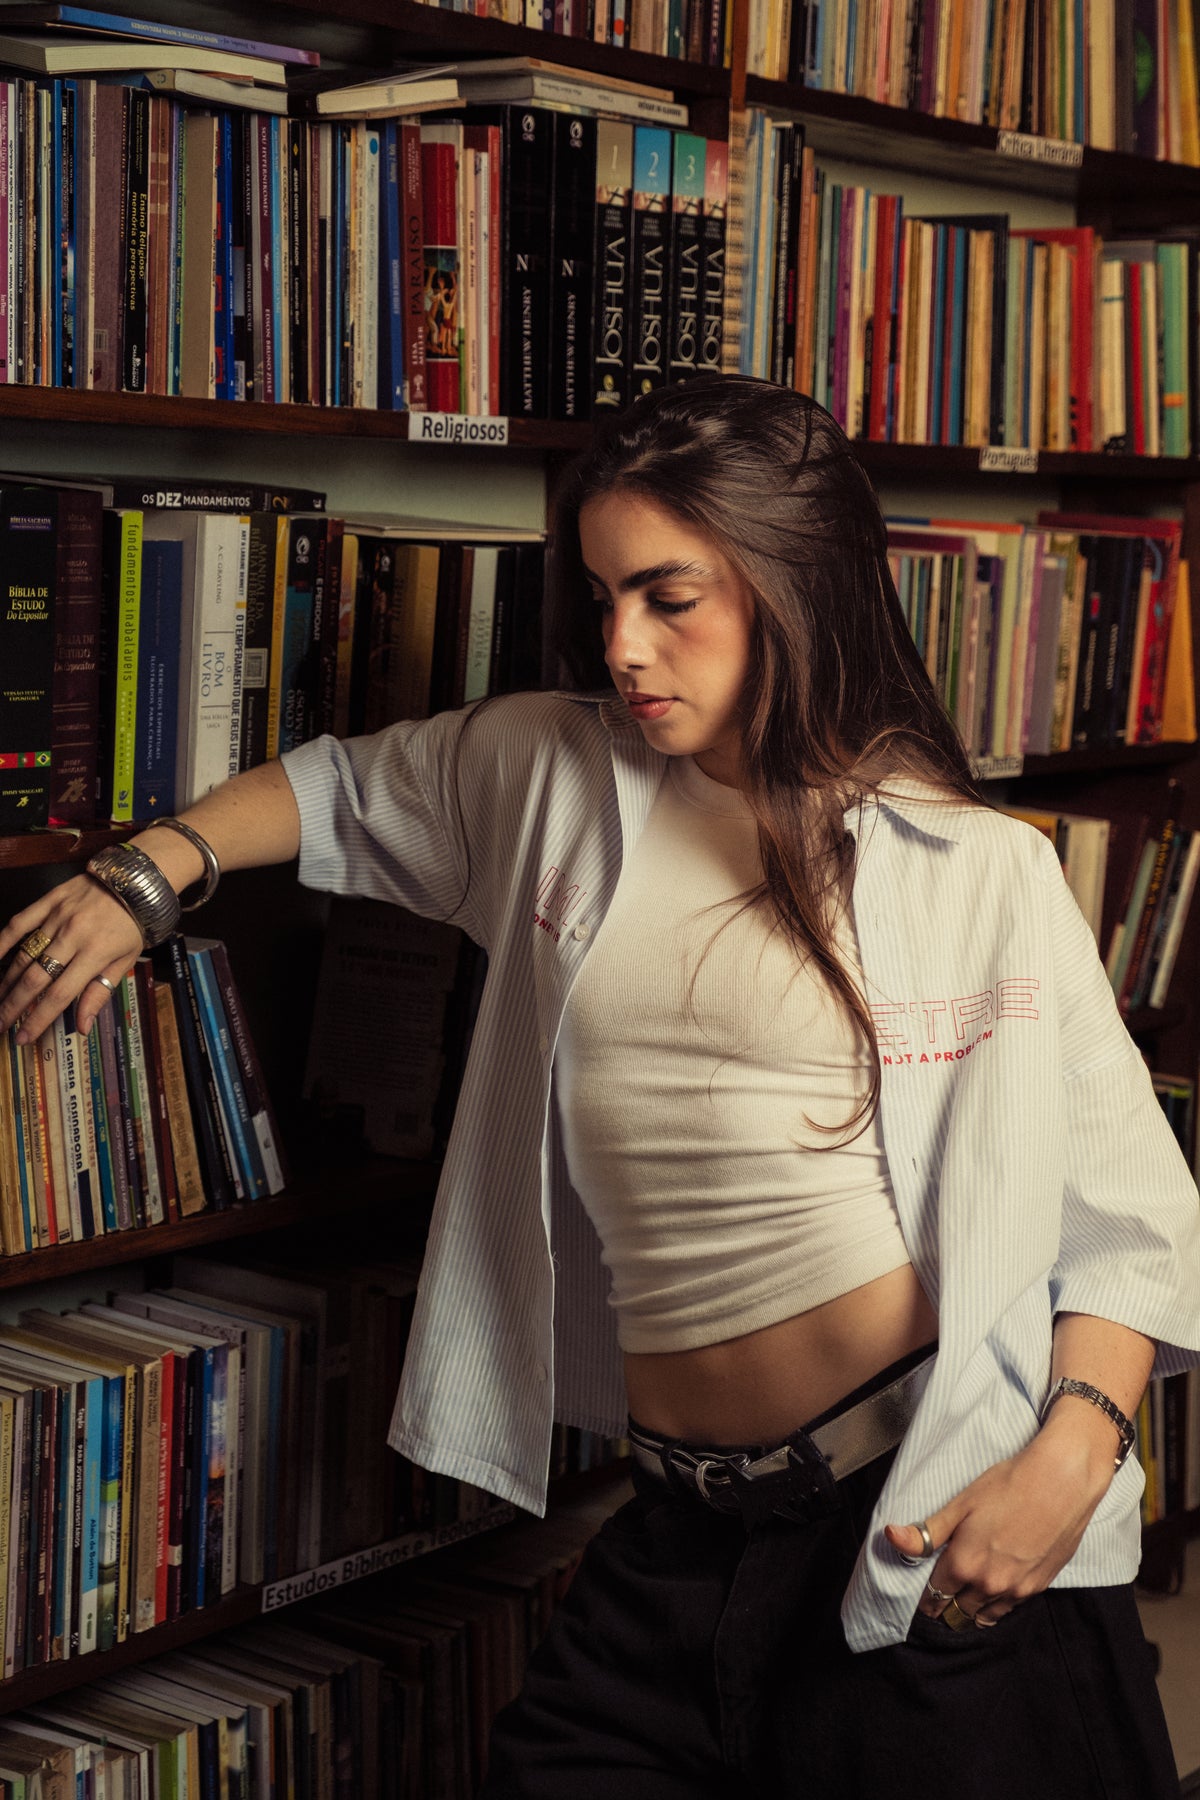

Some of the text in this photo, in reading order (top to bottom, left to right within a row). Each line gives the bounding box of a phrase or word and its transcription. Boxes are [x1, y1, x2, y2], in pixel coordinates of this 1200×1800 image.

[245, 164, 251, 176] AO
[261, 146, 269, 217] HYPERNIKOMEN
[647, 151, 660, 177] 2
[684, 154, 696, 181] 3
[710, 159, 722, 184] 4
[131, 191, 139, 237] memória
[137, 193, 147, 280] Ensino Religioso:
[129, 248, 138, 311] perspectivas
[595, 236, 625, 368] JOSHUA
[632, 245, 665, 375] JOSHUA
[670, 243, 700, 372] JOSHUA
[696, 247, 725, 373] JOSHUA
[522, 285, 533, 412] MATTHEW HENRY
[565, 291, 576, 416] MATTHEW HENRY
[421, 415, 506, 444] Religiosos
[142, 491, 251, 508] OS DEZ MANDAMENTOS
[125, 524, 140, 604] fundamentos
[215, 562, 223, 604] GRAYLING
[255, 543, 268, 620] MANUAL DA
[316, 577, 324, 585] E
[8, 584, 49, 598] BÍBLIA DE
[12, 599, 46, 611] ESTUDO
[6, 611, 49, 622] Do Expositor
[313, 586, 323, 641] PERDOAR
[148, 655, 157, 704] ILUSTRADOS
[201, 643, 213, 697] LIVRO
[214, 651, 225, 688] BOM
[232, 623, 244, 697] TEMPERAMENTO
[155, 663, 165, 760] EXERCÍCIOS ESPIRITUAIS
[231, 699, 241, 717] QUE
[229, 743, 239, 760] LHE
[230, 718, 240, 742] DEUS
[174, 961, 183, 980] PIER
[127, 982, 142, 1057] PASTOR INQUIETO
[224, 986, 236, 1015] NOVO
[231, 1015, 254, 1079] TESTAMENTO
[65, 1038, 72, 1046] A
[883, 1029, 994, 1067] NOT A PROBLEM
[66, 1049, 75, 1089] IGREJA
[84, 1077, 92, 1094] NA
[28, 1075, 38, 1120] LIBERTAÇÃO
[33, 1130, 41, 1163] LITURGIA
[69, 1095, 83, 1170] ENSINADORA
[125, 1119, 136, 1161] EM CRISTO
[3, 1413, 11, 1432] Para
[1, 1447, 10, 1492] Momentos
[73, 1492, 82, 1548] UNIVERSITÁRIOS
[156, 1506, 166, 1568] PROCLAMAR
[88, 1551, 96, 1580] Botton
[89, 1541, 96, 1551] de
[265, 1569, 338, 1610] Estudos
[341, 1547, 409, 1582] Bíblicos
[413, 1538, 425, 1557] e
